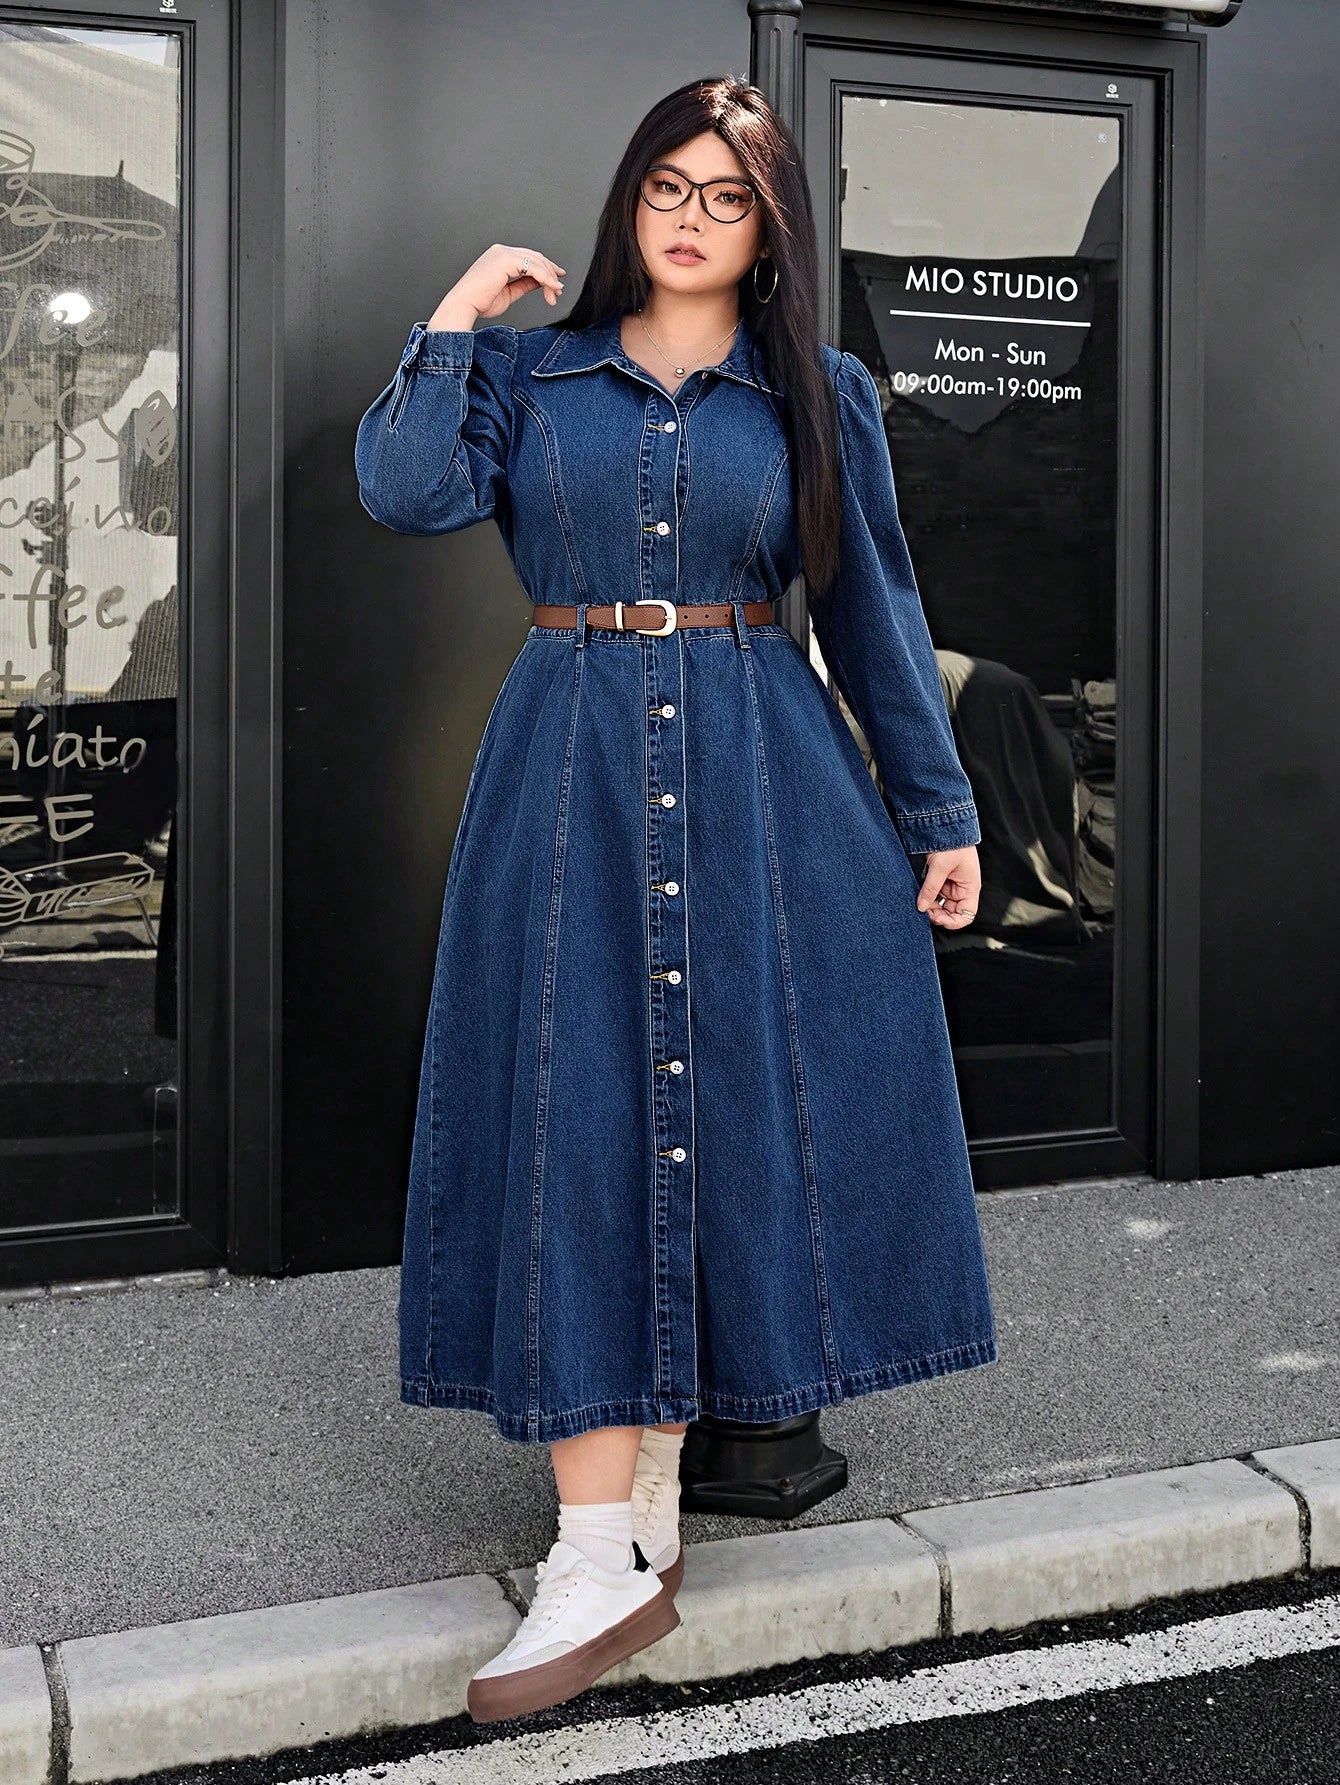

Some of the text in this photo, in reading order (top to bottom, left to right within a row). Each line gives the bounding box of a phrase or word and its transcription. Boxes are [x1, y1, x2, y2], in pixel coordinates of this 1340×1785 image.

[905, 265, 1079, 302] MIO STUDIO
[934, 338, 984, 362] Mon
[1006, 342, 1046, 366] Sun
[893, 371, 1082, 404] 09:00am-19:00pm
